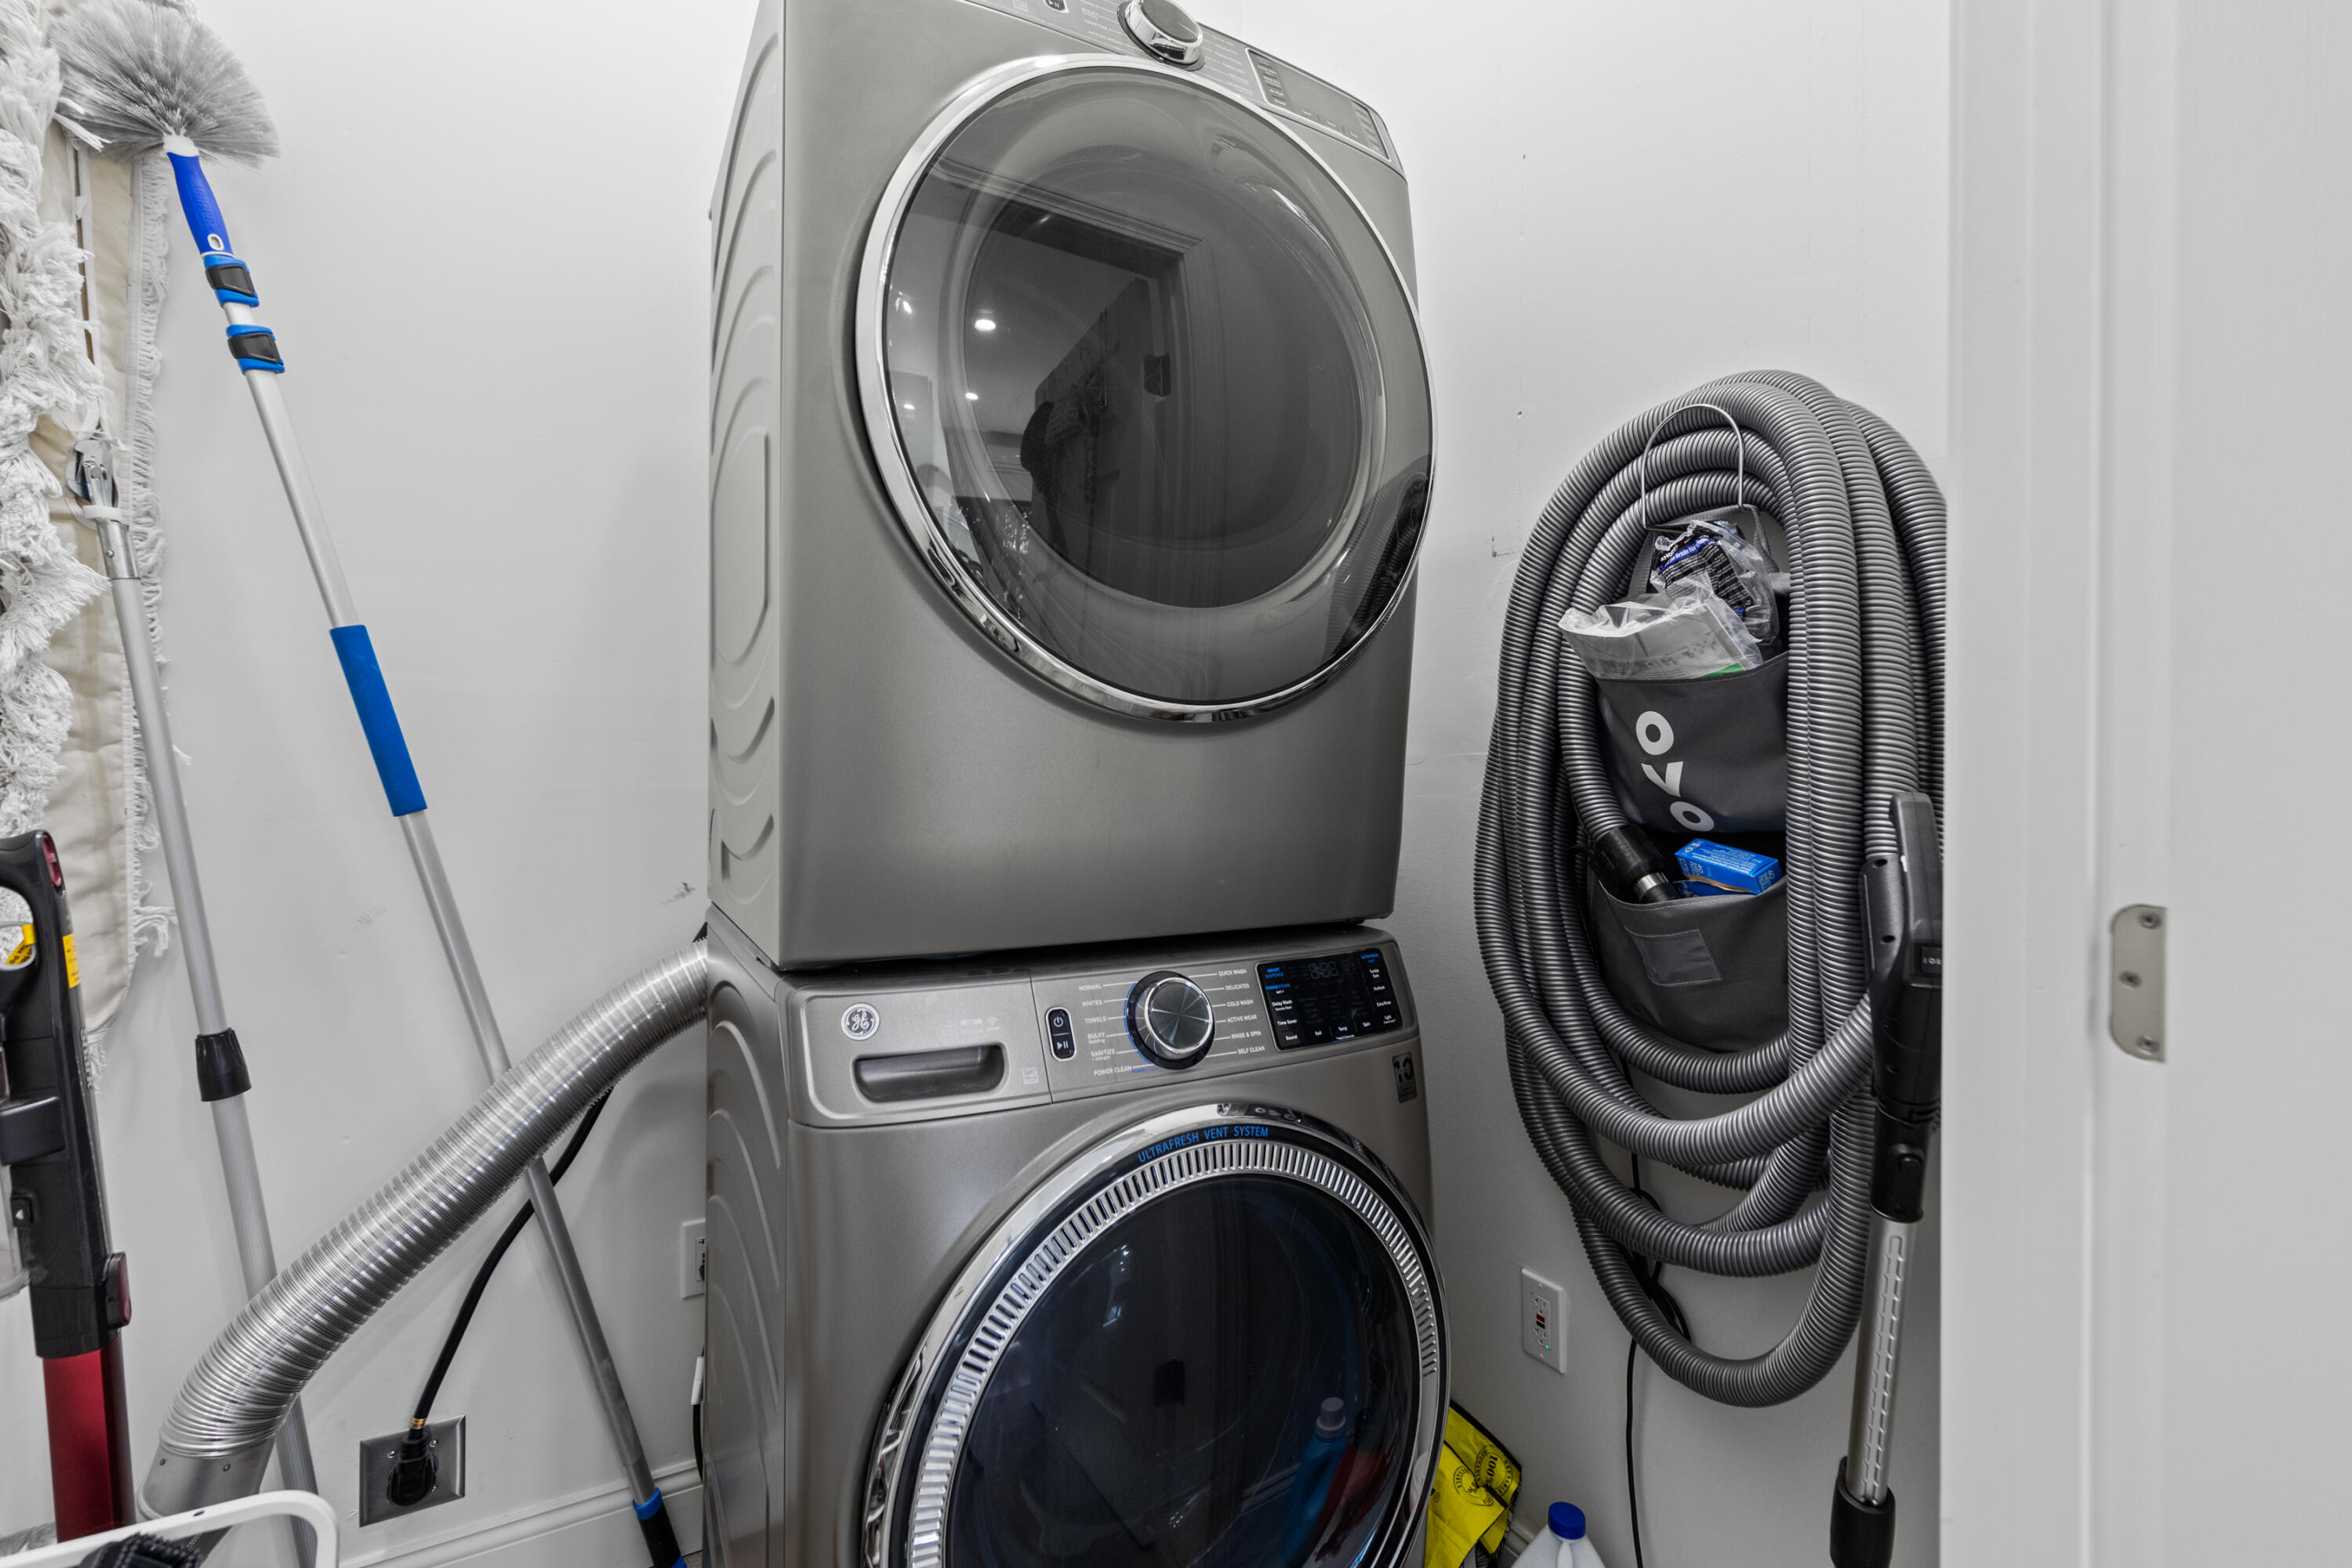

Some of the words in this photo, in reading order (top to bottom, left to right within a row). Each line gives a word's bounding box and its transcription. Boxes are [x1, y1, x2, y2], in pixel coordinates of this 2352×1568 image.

[1635, 710, 1715, 832] OVO
[1091, 1048, 1116, 1057] SANITIZE
[1138, 1131, 1200, 1163] ULTRAFRESH
[1204, 1127, 1229, 1140] VENT
[1234, 1126, 1269, 1138] SYSTEM
